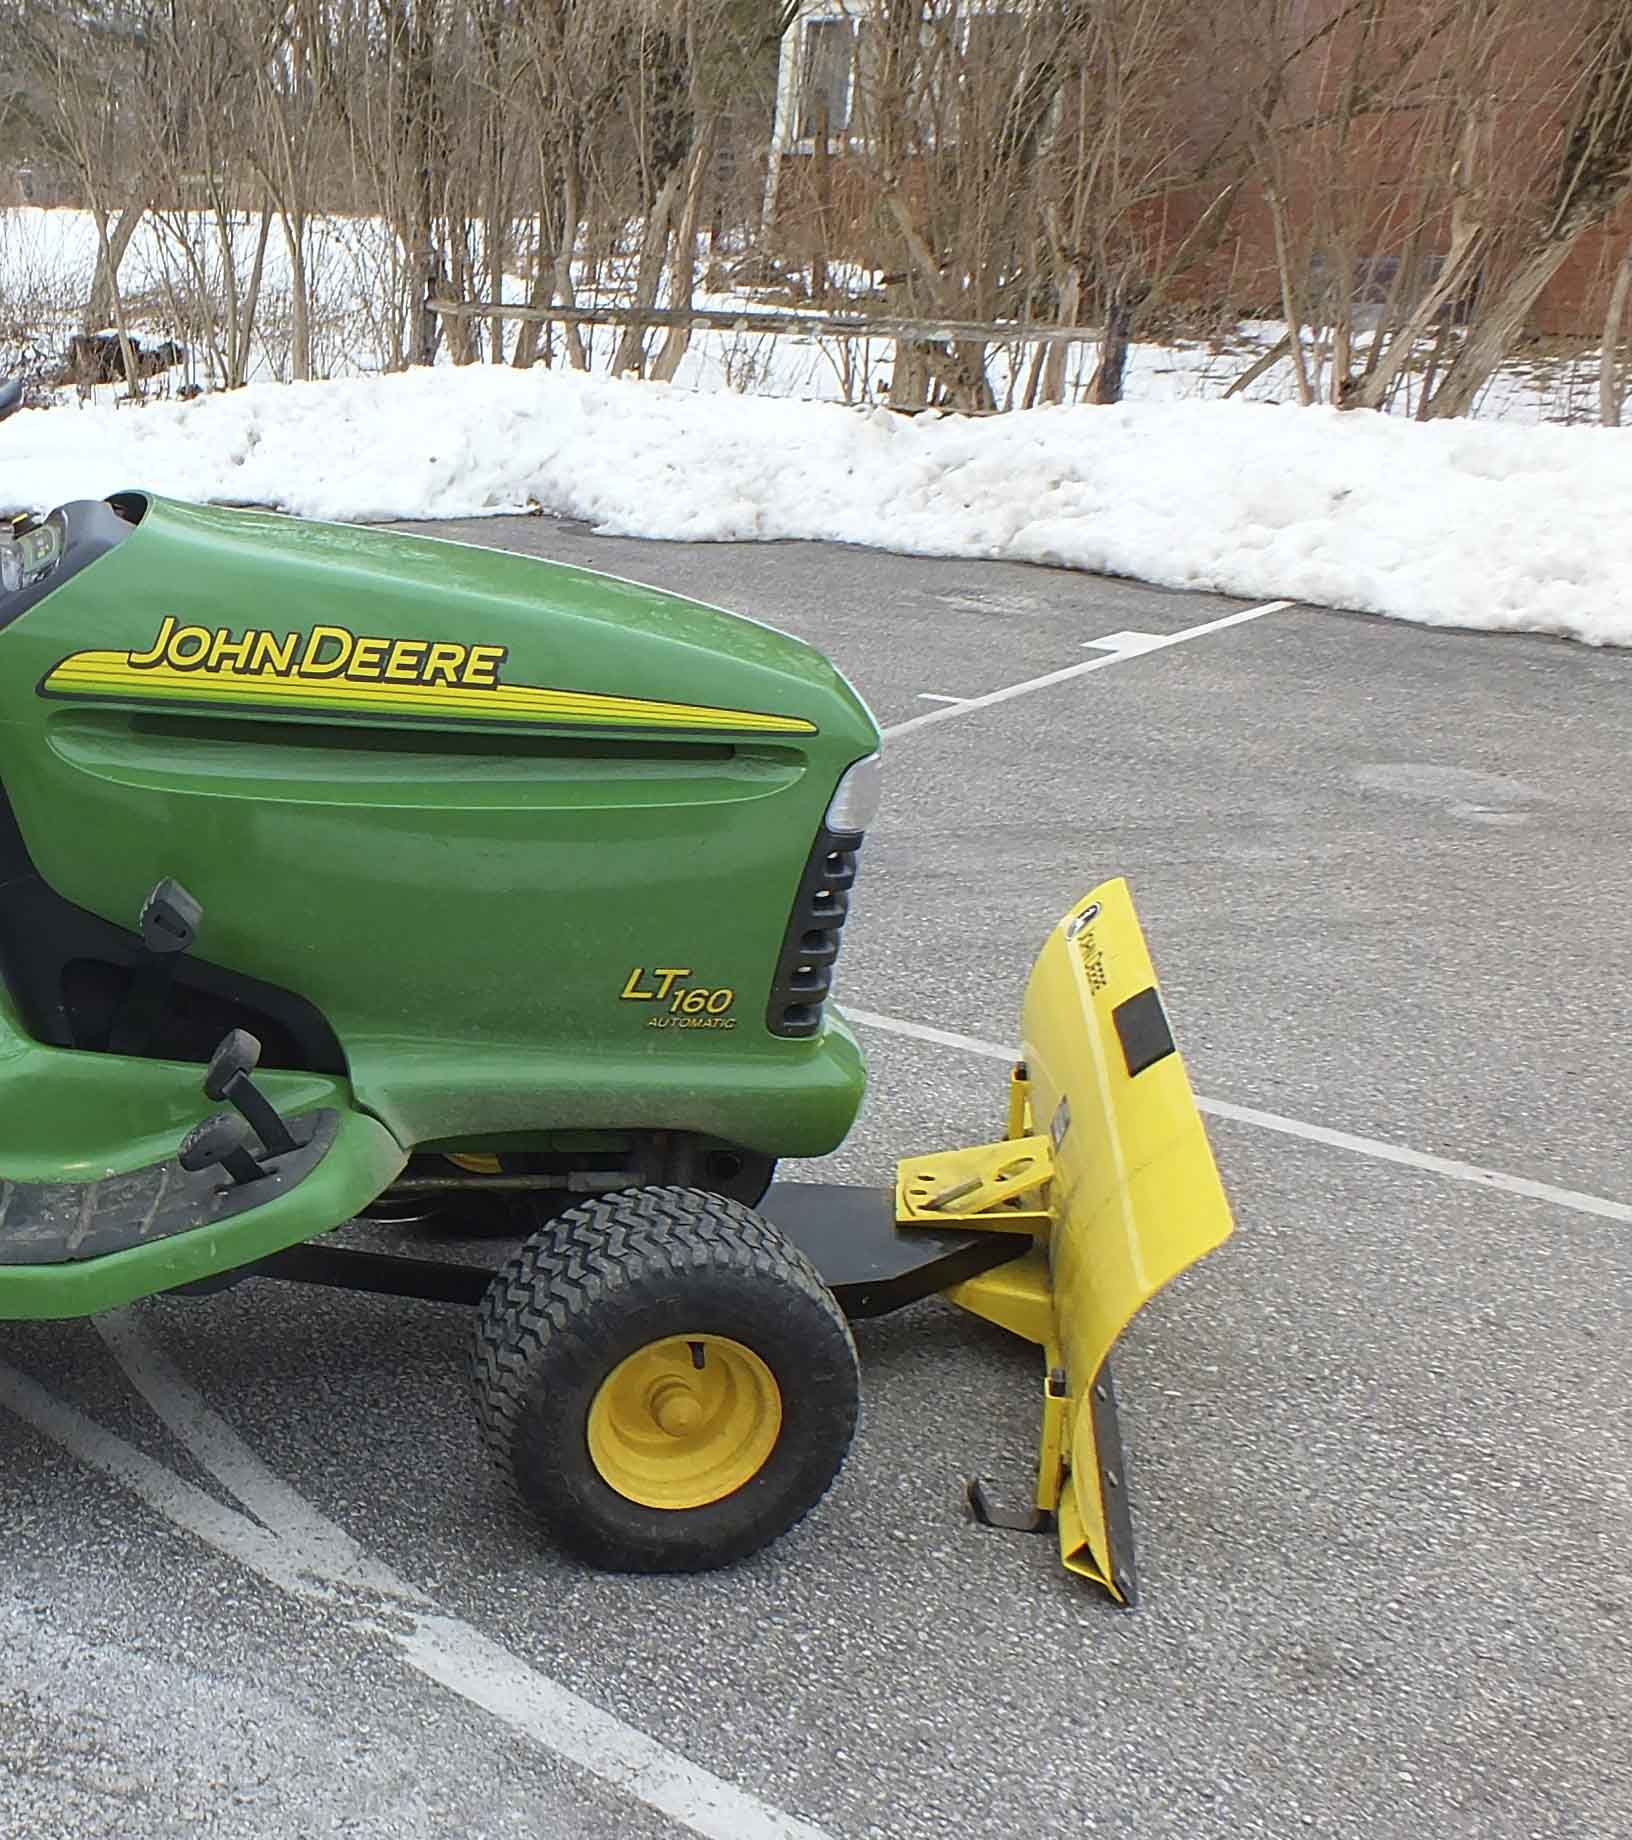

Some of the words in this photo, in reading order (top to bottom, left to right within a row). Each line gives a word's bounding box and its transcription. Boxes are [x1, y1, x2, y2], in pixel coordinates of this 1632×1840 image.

[128, 615, 300, 673] JOHN
[298, 624, 507, 690] DEERE
[647, 1016, 737, 1031] AUTOMATIC
